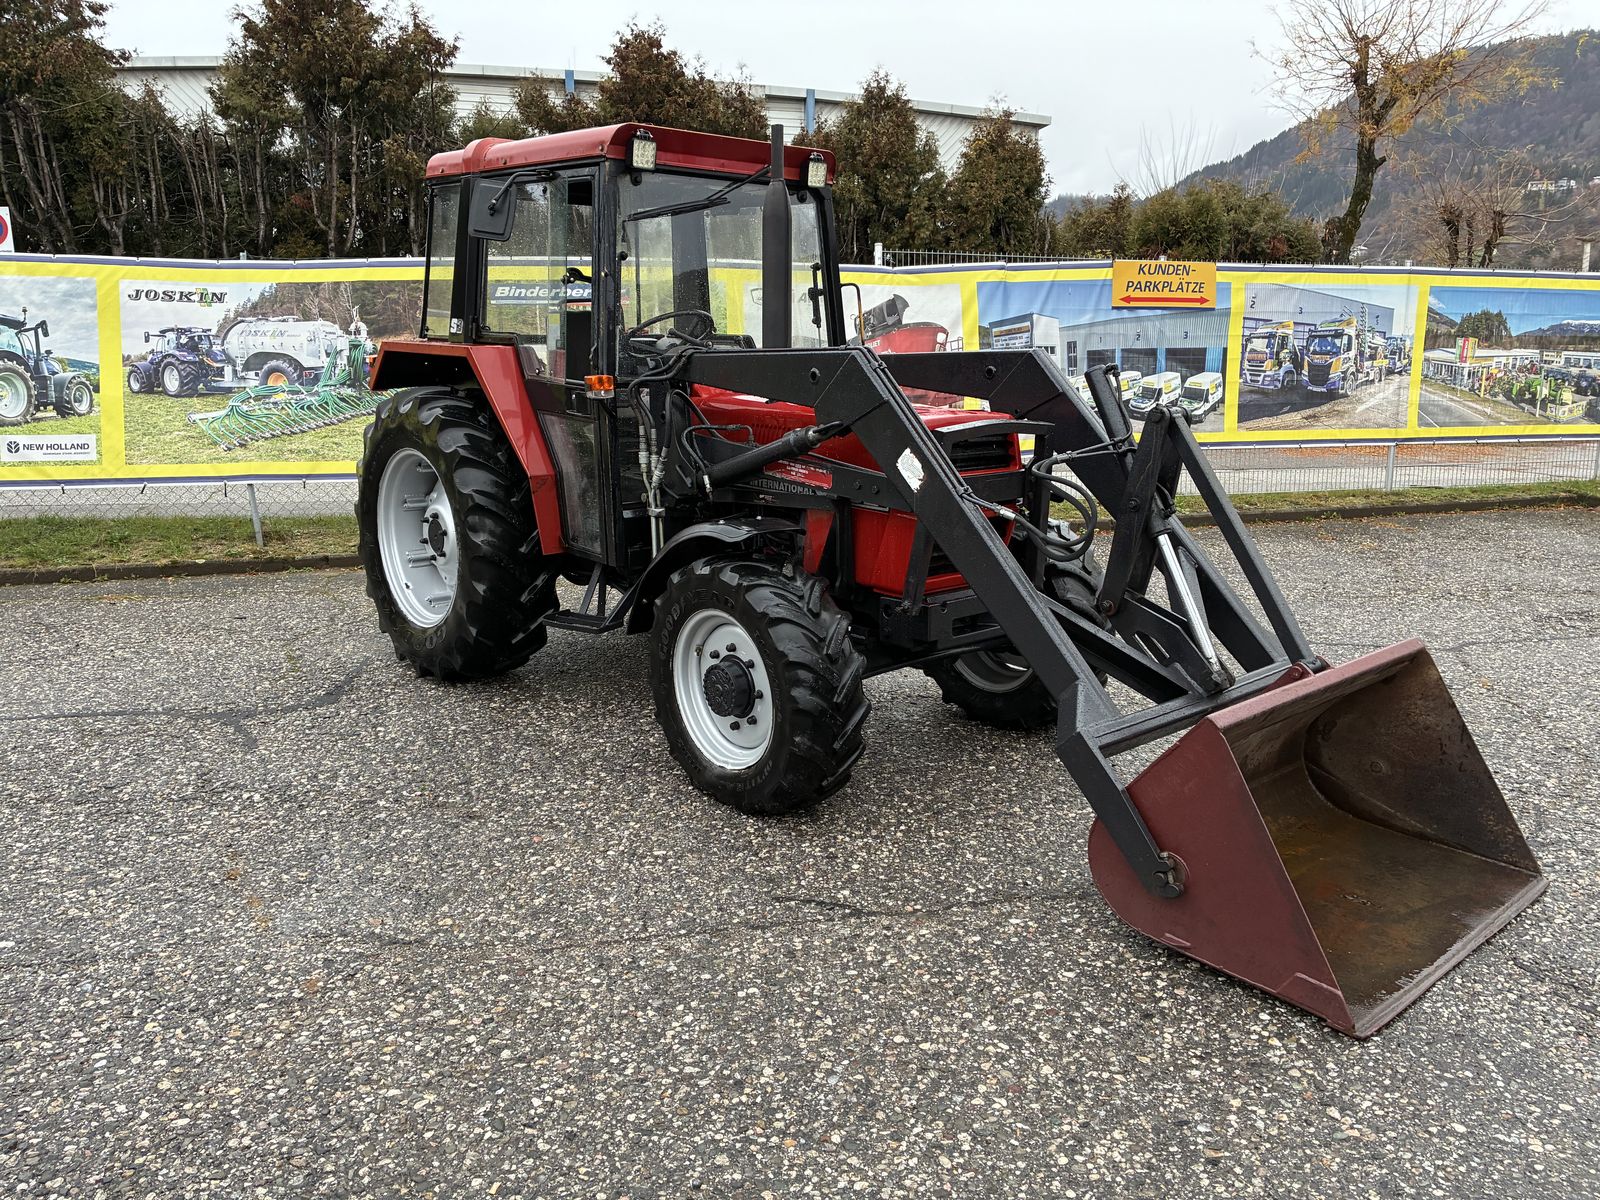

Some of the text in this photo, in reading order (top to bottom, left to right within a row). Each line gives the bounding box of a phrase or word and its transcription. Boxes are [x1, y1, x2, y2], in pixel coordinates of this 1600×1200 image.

[1138, 263, 1197, 276] KUNDEN-
[495, 286, 626, 297] Binderber
[1125, 277, 1206, 293] PARKPLÄTZE
[127, 289, 228, 304] JOSKIN
[22, 443, 90, 451] NEW HOLLAND
